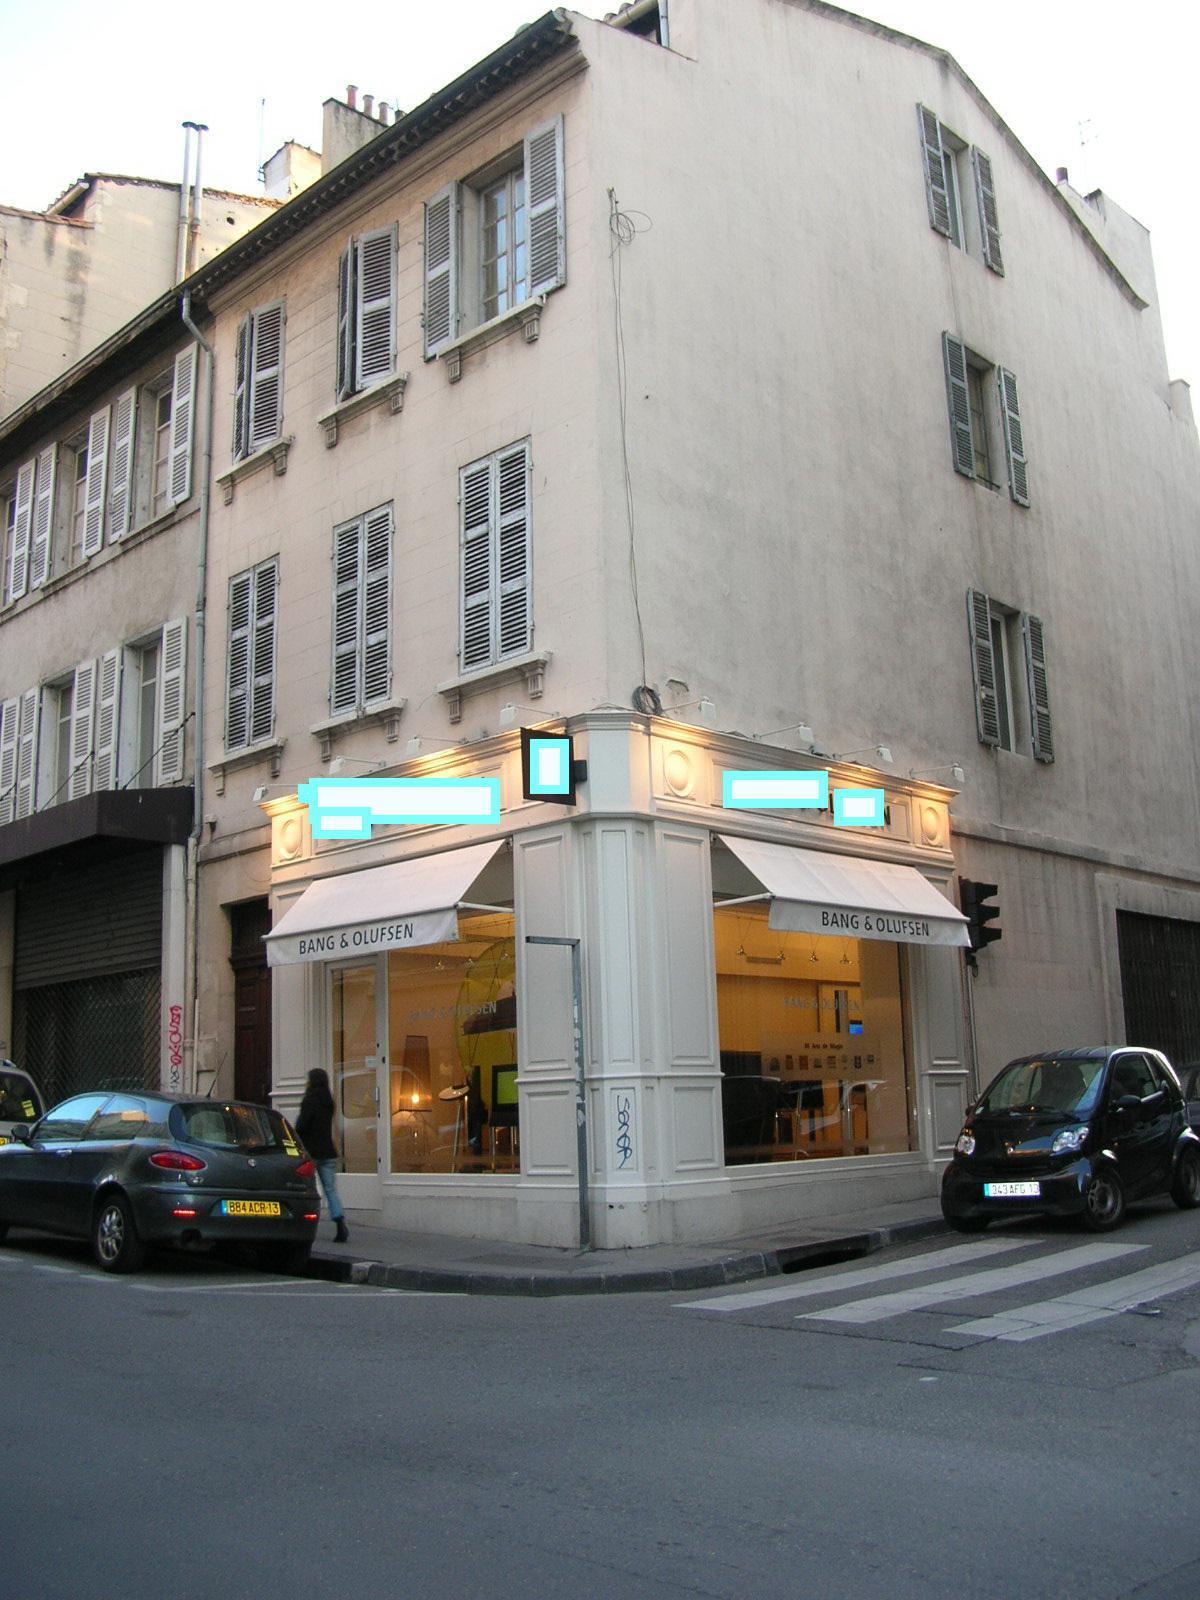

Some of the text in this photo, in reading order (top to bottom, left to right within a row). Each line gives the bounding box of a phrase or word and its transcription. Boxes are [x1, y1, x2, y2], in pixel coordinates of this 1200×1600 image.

[822, 911, 930, 937] BANG & OLUFSEN
[299, 923, 414, 955] BANG & OLUFSEN
[992, 1183, 1040, 1194] 343 AFG 13
[248, 1202, 266, 1214] ACR
[267, 1203, 279, 1213] 13
